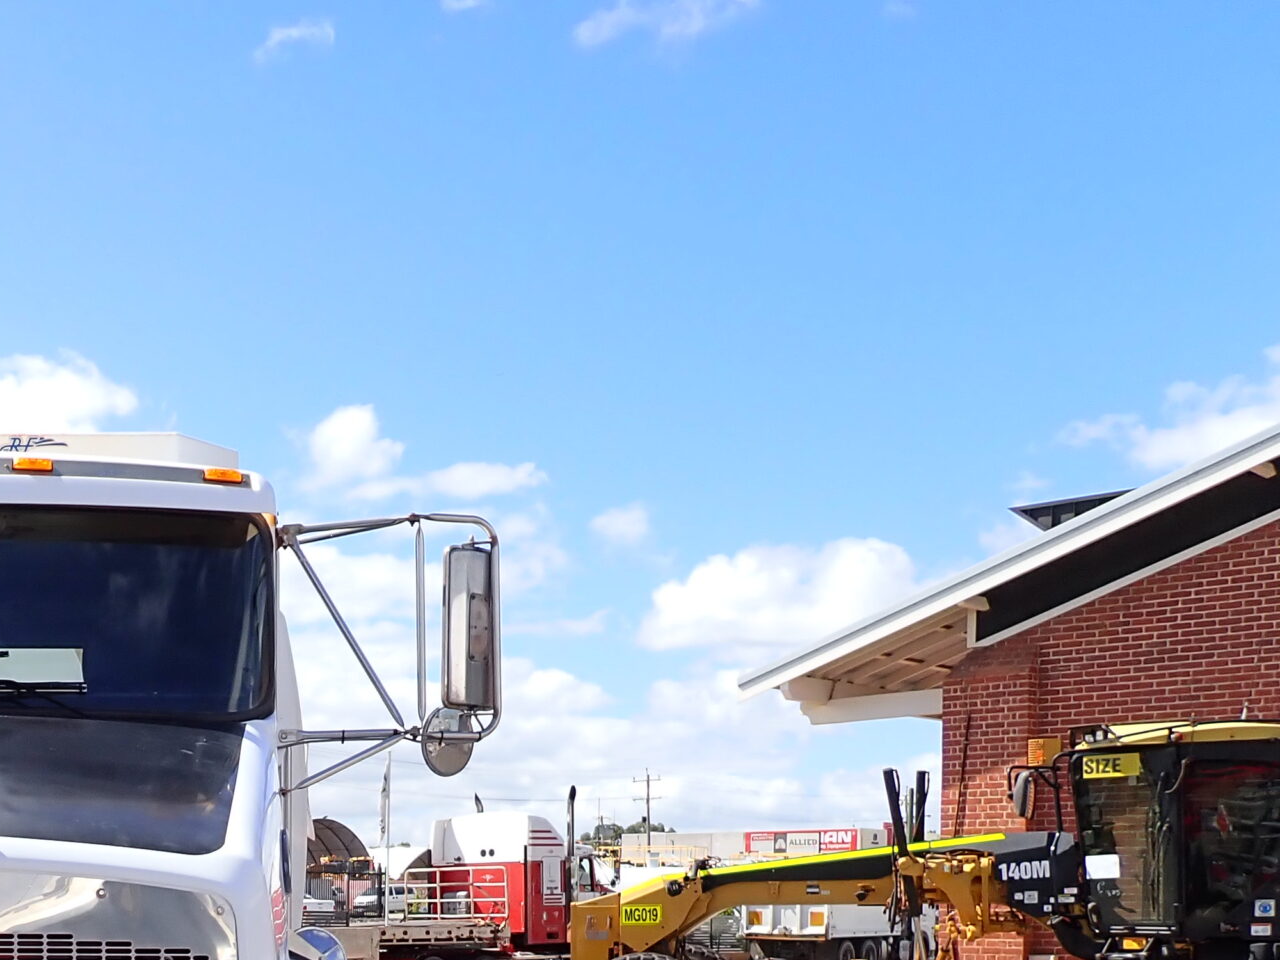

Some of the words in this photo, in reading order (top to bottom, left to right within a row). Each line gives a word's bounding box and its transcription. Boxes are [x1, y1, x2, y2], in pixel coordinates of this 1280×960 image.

[1084, 758, 1121, 775] SIZE
[789, 838, 818, 846] ALLIED
[998, 860, 1050, 881] 140M
[624, 907, 658, 922] MG019
